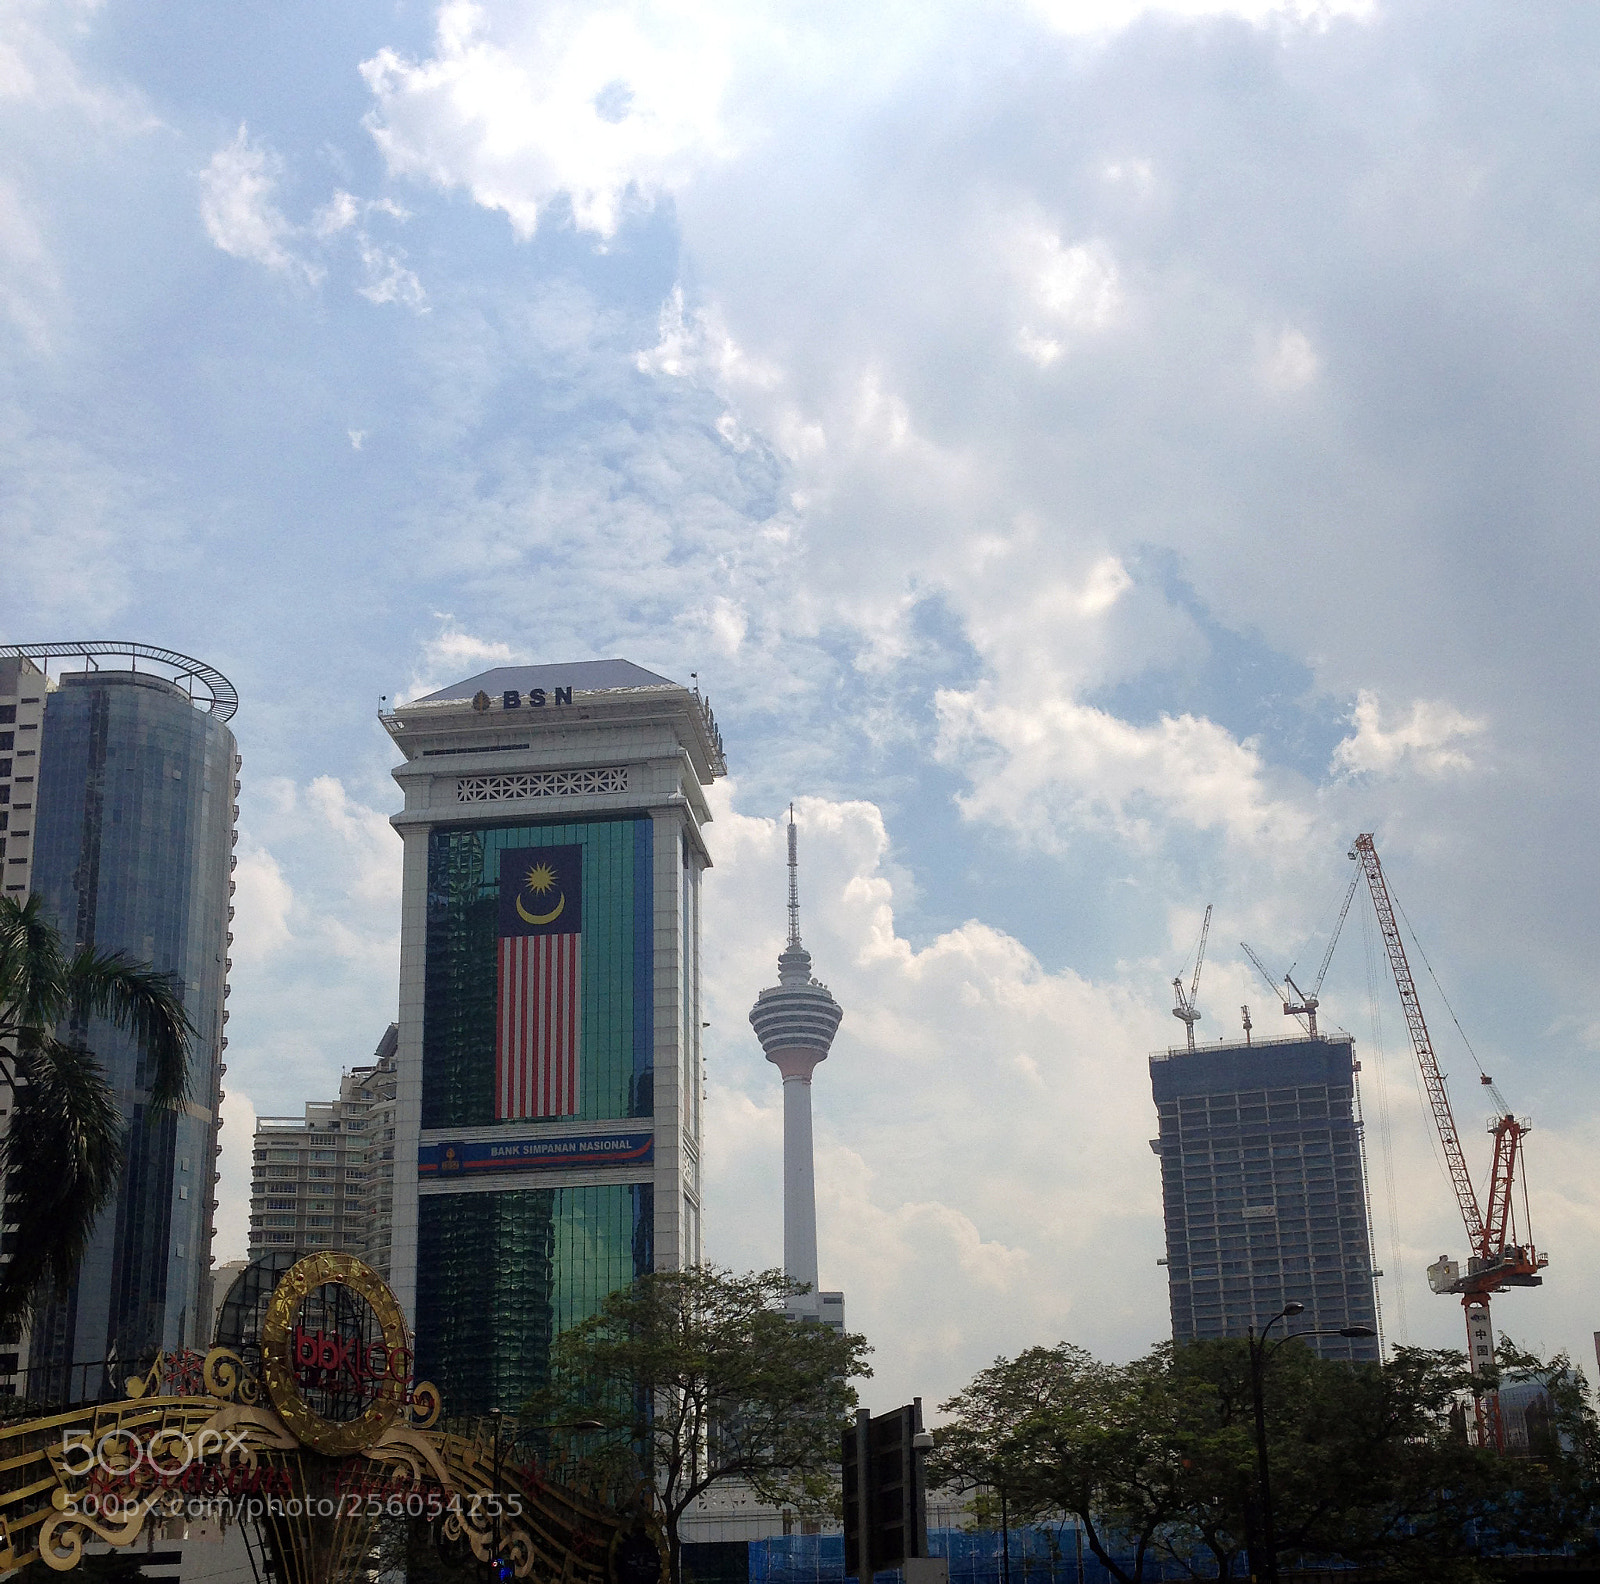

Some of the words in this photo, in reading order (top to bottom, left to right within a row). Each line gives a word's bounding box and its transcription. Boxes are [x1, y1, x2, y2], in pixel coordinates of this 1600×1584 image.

[503, 686, 573, 709] BSN
[491, 1145, 520, 1157] BANK
[523, 1144, 577, 1155] SIMPANAN
[579, 1140, 633, 1152] NASIONAL
